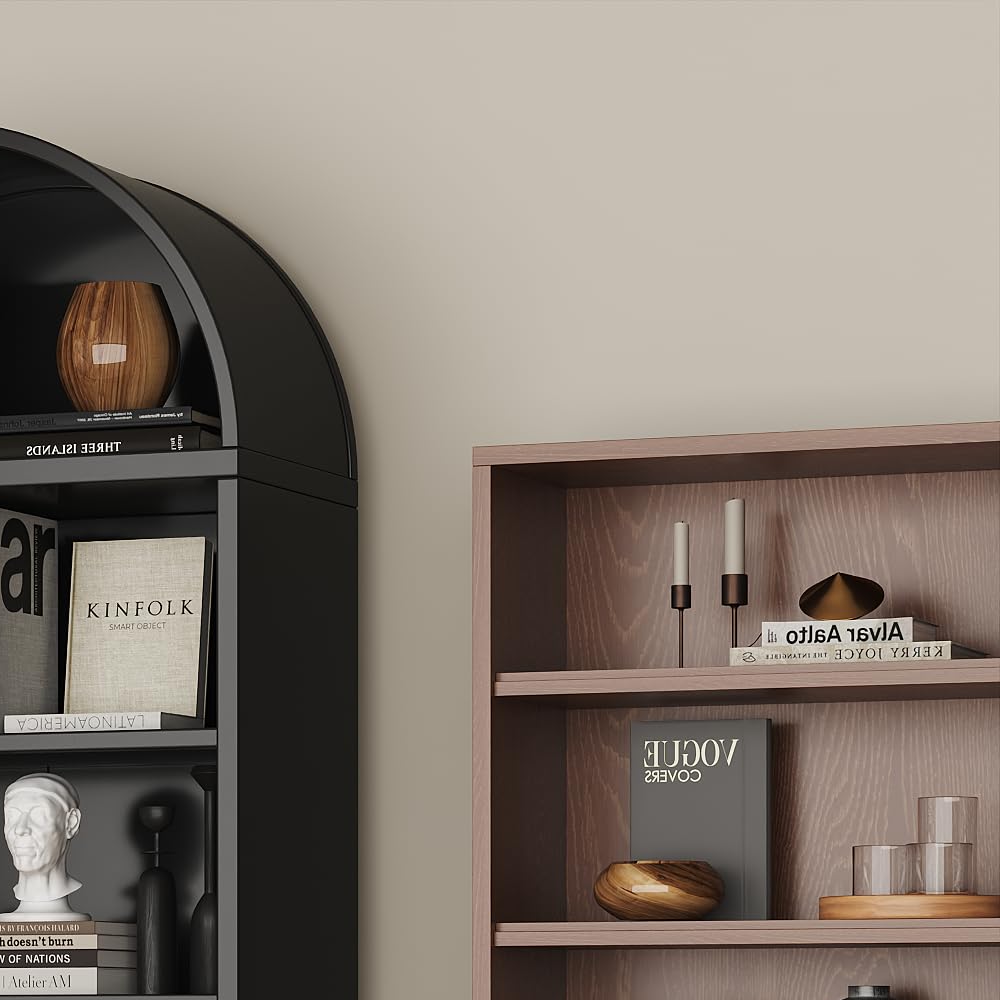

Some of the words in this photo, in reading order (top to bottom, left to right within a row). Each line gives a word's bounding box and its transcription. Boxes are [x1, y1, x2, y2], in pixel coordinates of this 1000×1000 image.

[1, 518, 56, 616] ar
[87, 600, 194, 618] KINFOLK
[136, 622, 166, 630] OBJECT
[18, 715, 144, 731] LATINOAMERICA
[17, 924, 50, 932] FRANÇOIS
[9, 954, 21, 963] OF
[25, 954, 71, 964] NATIONS
[8, 975, 47, 988] Atelier
[50, 975, 71, 988] AM
